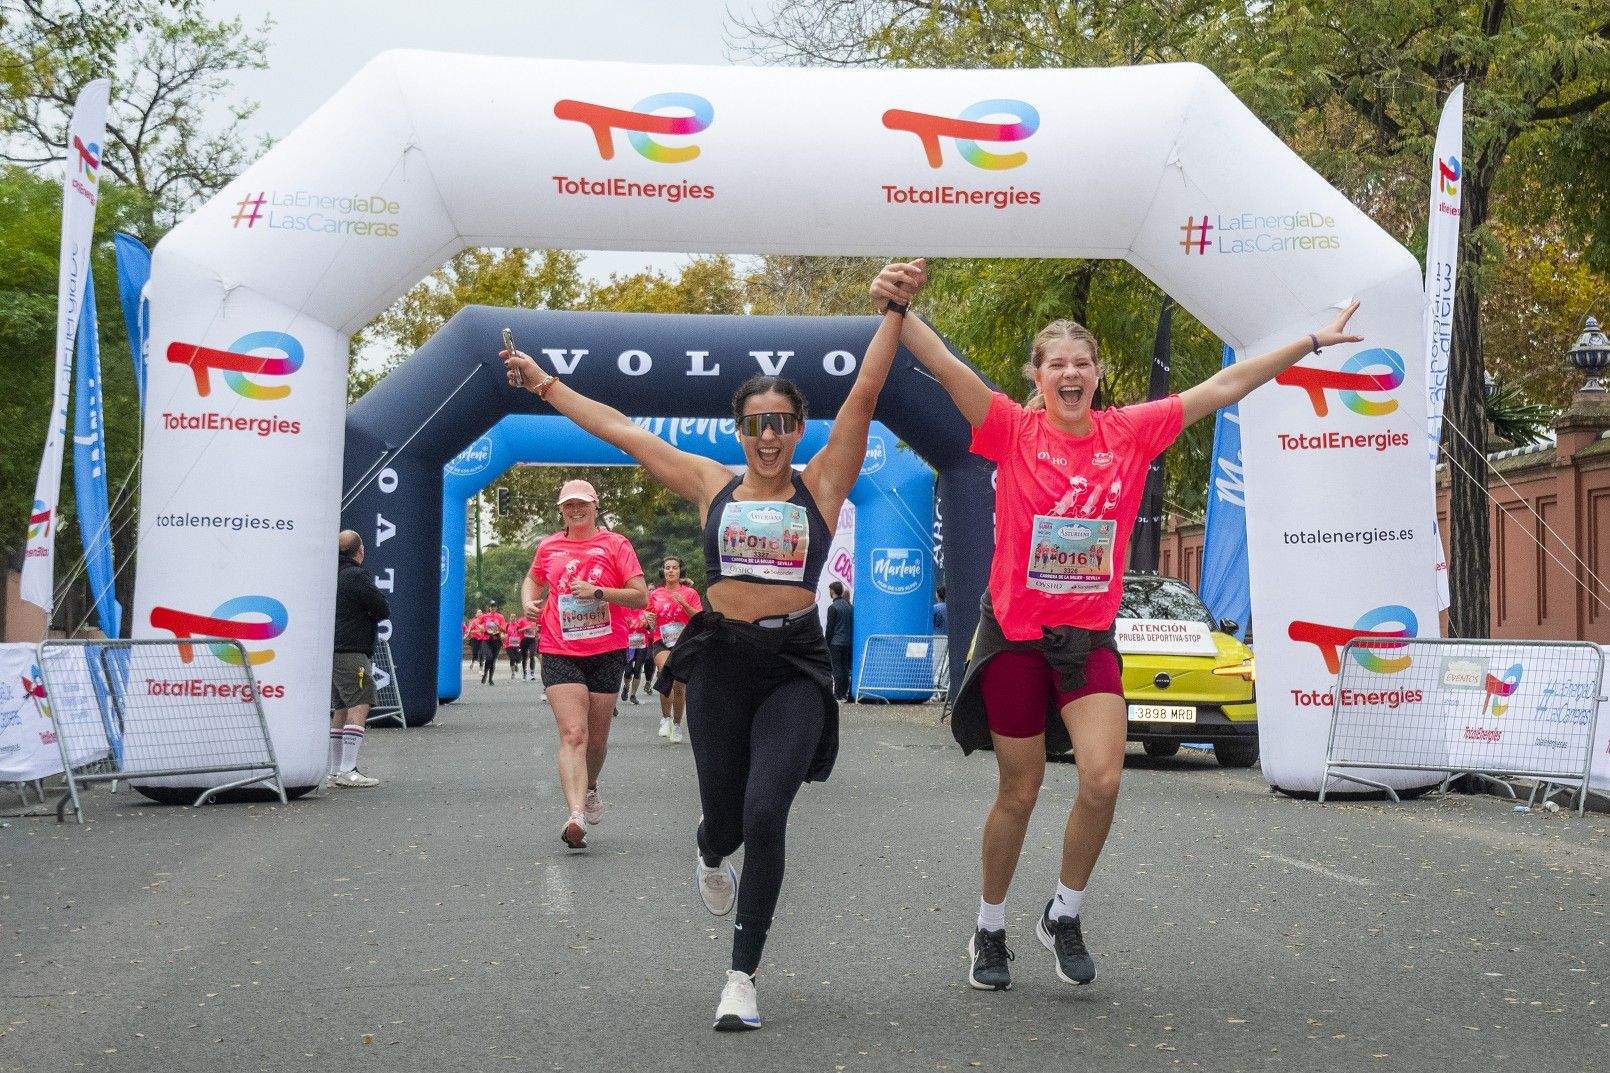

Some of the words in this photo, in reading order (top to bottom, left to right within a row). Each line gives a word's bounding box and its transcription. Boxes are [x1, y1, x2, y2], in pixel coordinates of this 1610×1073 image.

[553, 174, 714, 203] TotalEnergies
[881, 183, 1040, 210] TotalEnergies
[269, 211, 399, 237] LasCarreras
[1219, 234, 1340, 254] LasCarreras
[541, 348, 857, 377] VOLVO
[163, 412, 301, 437] TotalEnergies
[1278, 429, 1409, 452] TotalEnergies
[156, 512, 295, 531] totalenergies.es
[1283, 527, 1415, 546] totalenergies.es
[1058, 552, 1088, 565] 016
[1119, 633, 1146, 642] PRUEBA
[1131, 623, 1187, 633] ATENCIÓN
[146, 679, 285, 703] TotalEnergies
[1291, 689, 1423, 708] TotaEnergies
[1137, 707, 1167, 719] 3898
[1171, 709, 1193, 720] MRD
